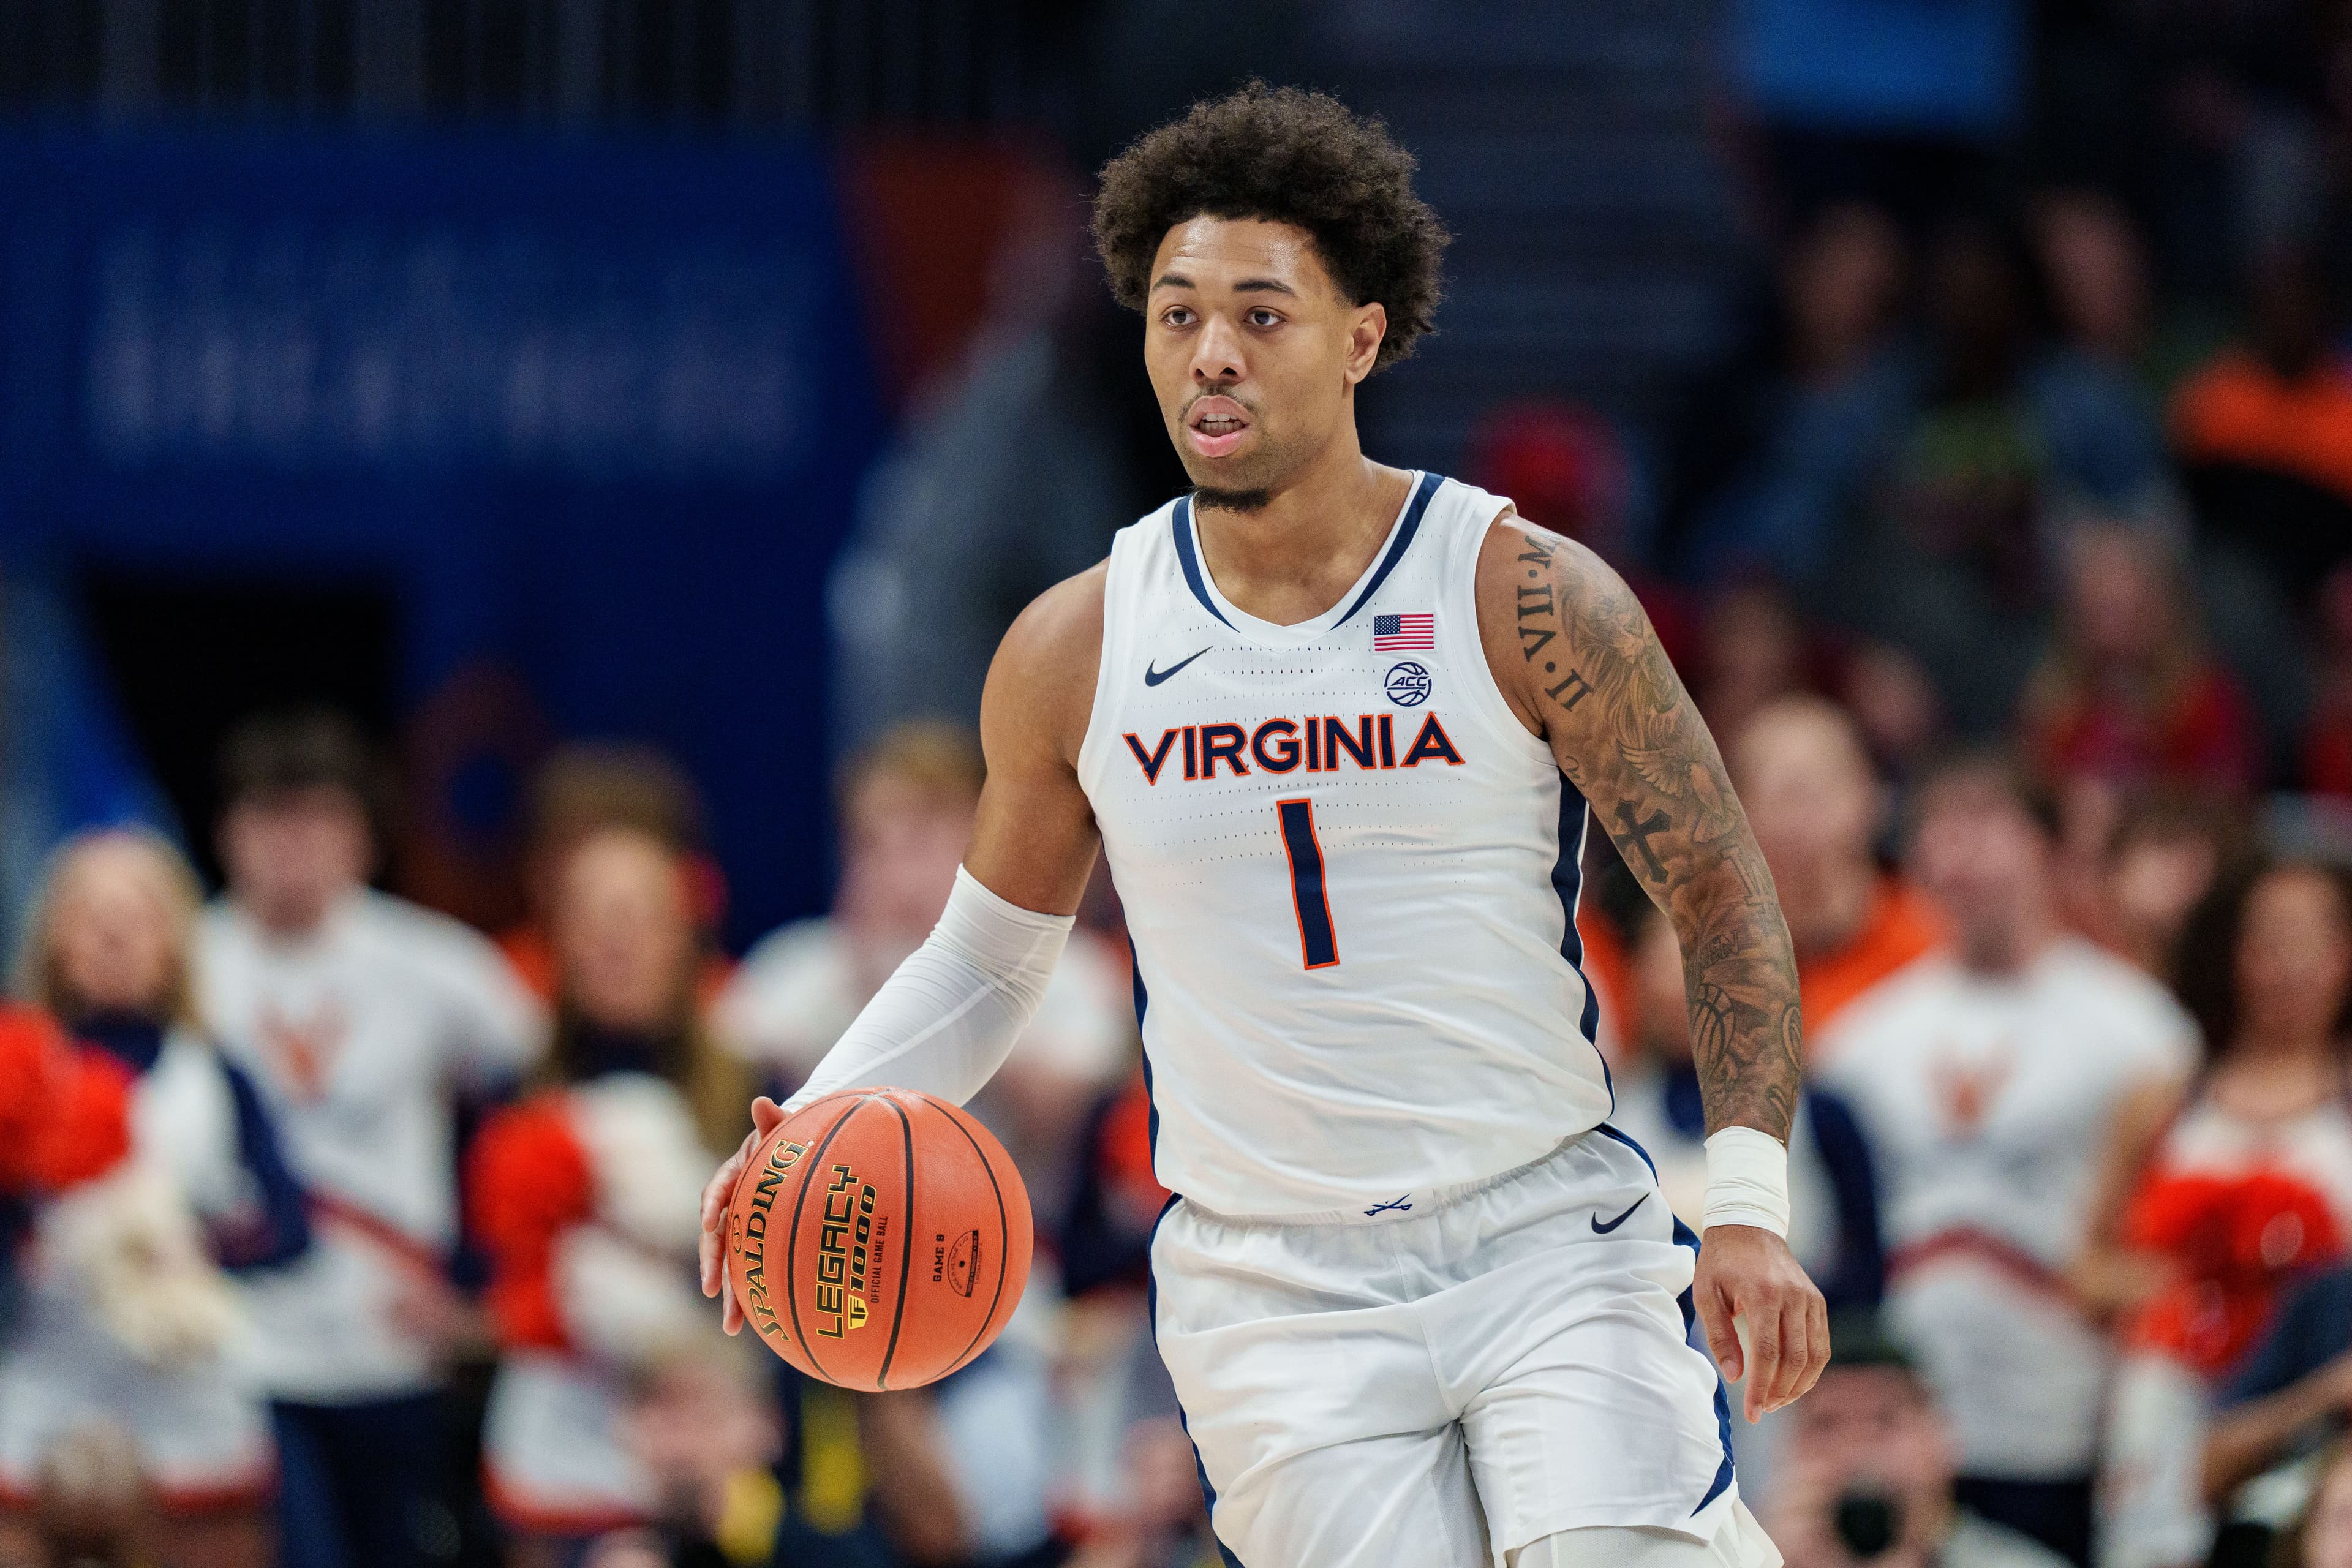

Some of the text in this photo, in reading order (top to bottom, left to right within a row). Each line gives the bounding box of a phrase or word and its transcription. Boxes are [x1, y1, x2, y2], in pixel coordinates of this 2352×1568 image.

[1391, 676, 1429, 686] ACC
[1122, 711, 1466, 786] VIRGINIA
[1276, 798, 1340, 970] 1
[744, 1139, 809, 1342] SPALDING
[816, 1164, 859, 1340] LEGACY
[850, 1183, 877, 1328] TF 1000
[870, 1216, 888, 1303] OFFICIAL GAME BALL
[933, 1247, 944, 1281] GAME
